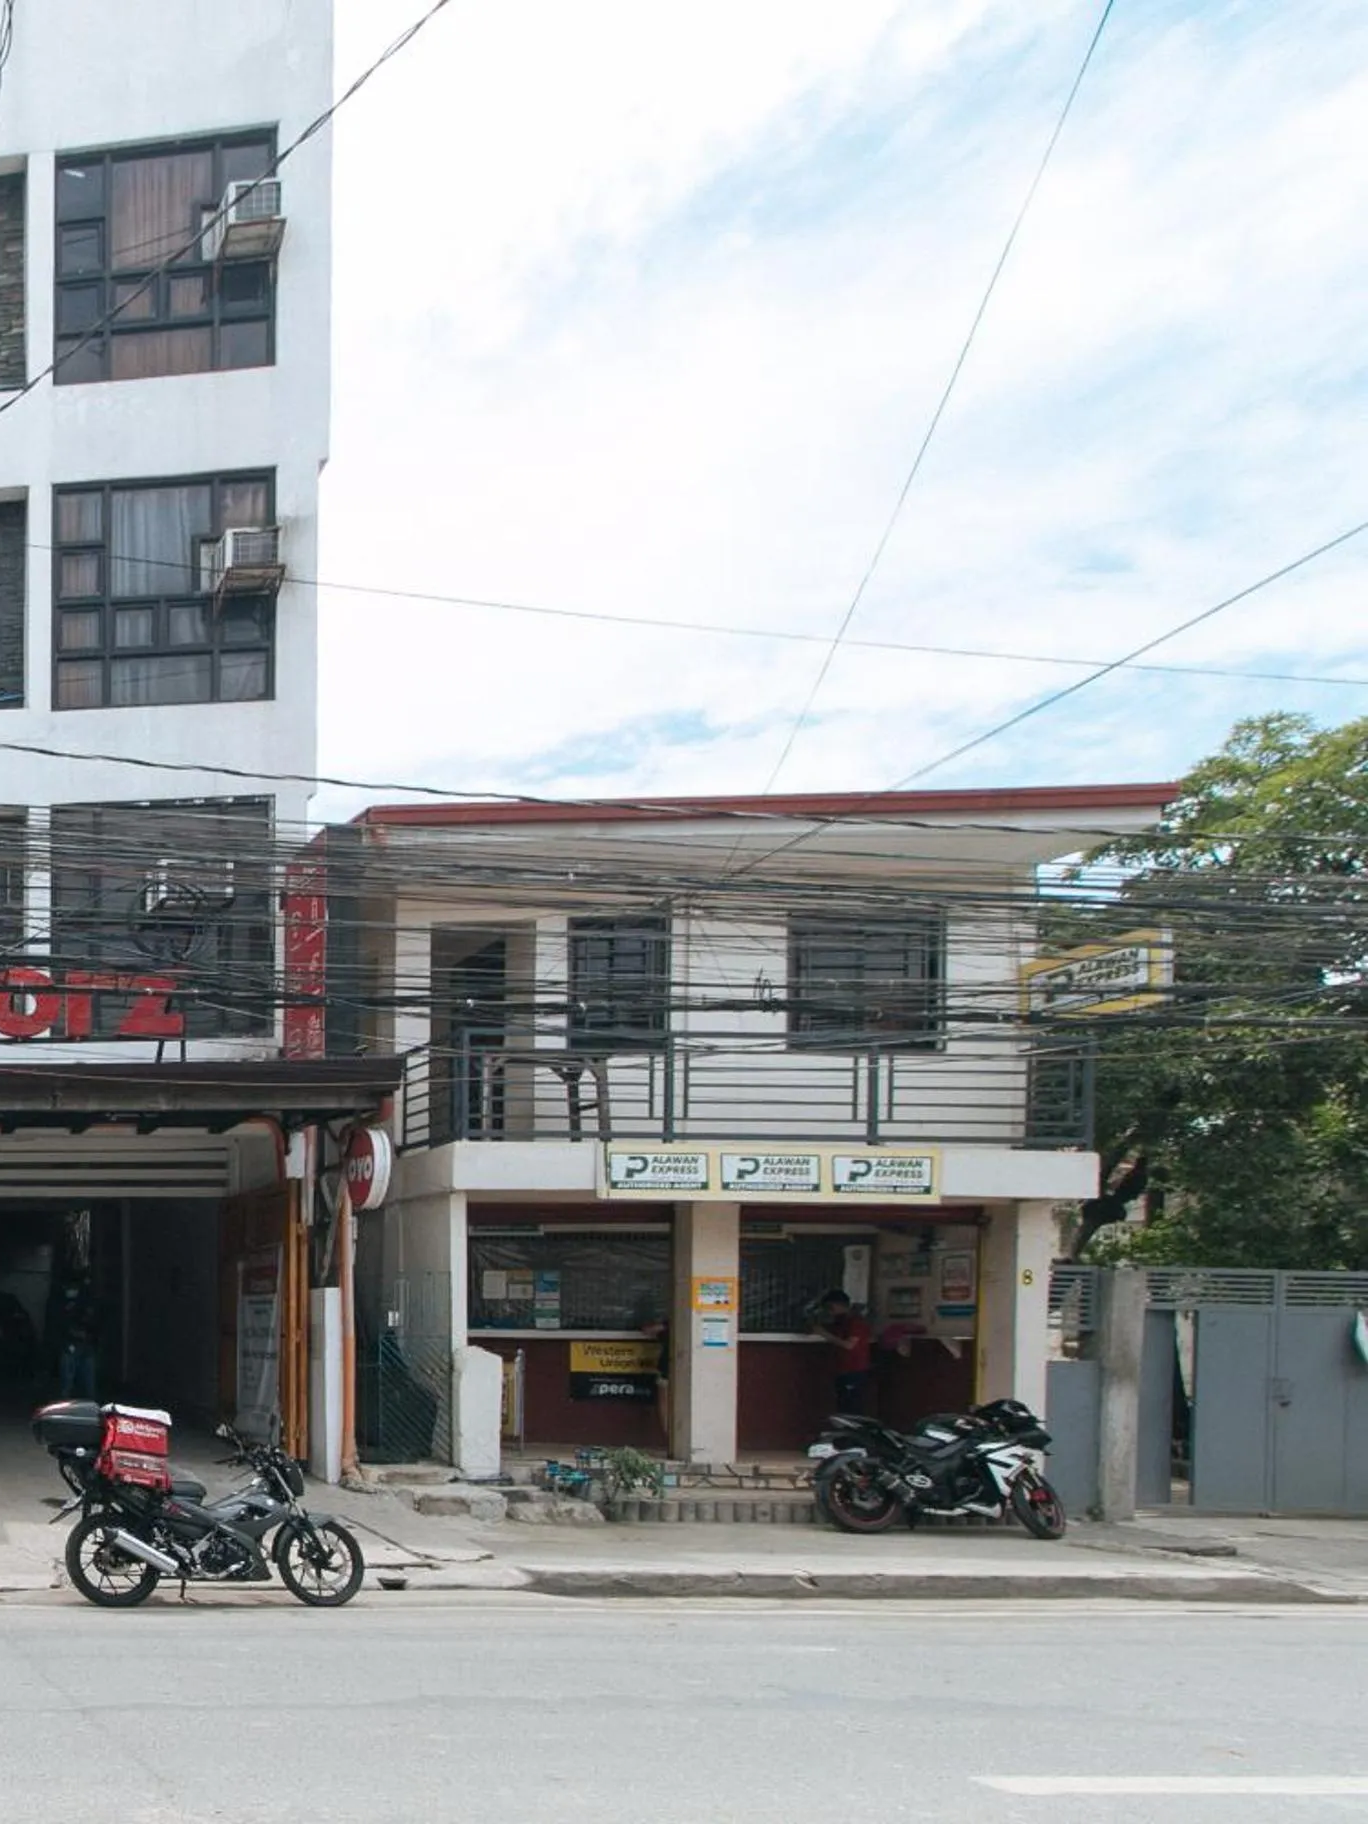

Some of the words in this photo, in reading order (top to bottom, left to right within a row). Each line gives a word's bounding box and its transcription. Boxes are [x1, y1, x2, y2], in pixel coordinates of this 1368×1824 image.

[348, 1154, 373, 1182] OYO
[650, 1165, 699, 1175] EXPRESS
[762, 1167, 811, 1176] EXPRESS
[874, 1169, 923, 1179] EXPRESS
